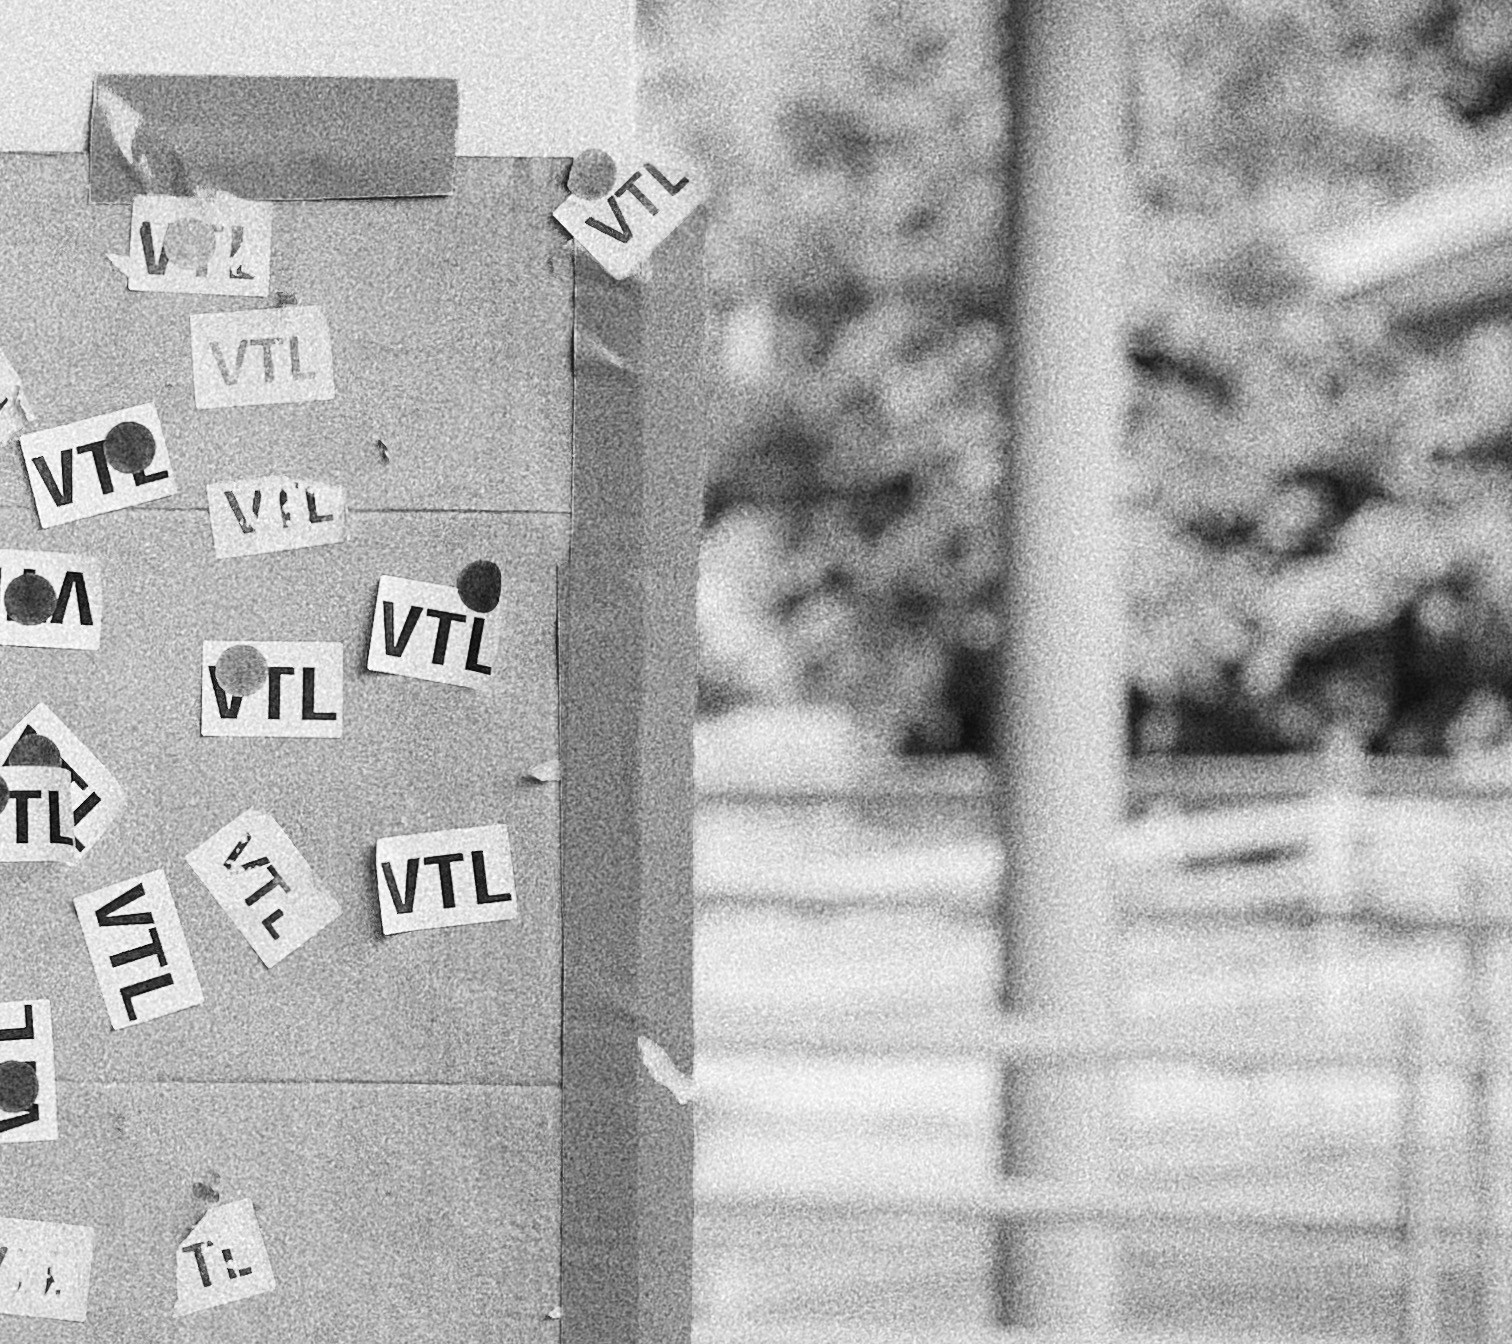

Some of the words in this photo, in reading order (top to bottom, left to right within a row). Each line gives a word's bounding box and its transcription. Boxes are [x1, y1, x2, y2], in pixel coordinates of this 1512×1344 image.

[585, 163, 690, 244] VTL
[207, 335, 317, 387] VTL
[382, 601, 492, 676] VTL
[381, 850, 513, 915] VTL
[95, 882, 175, 1021] VTL
